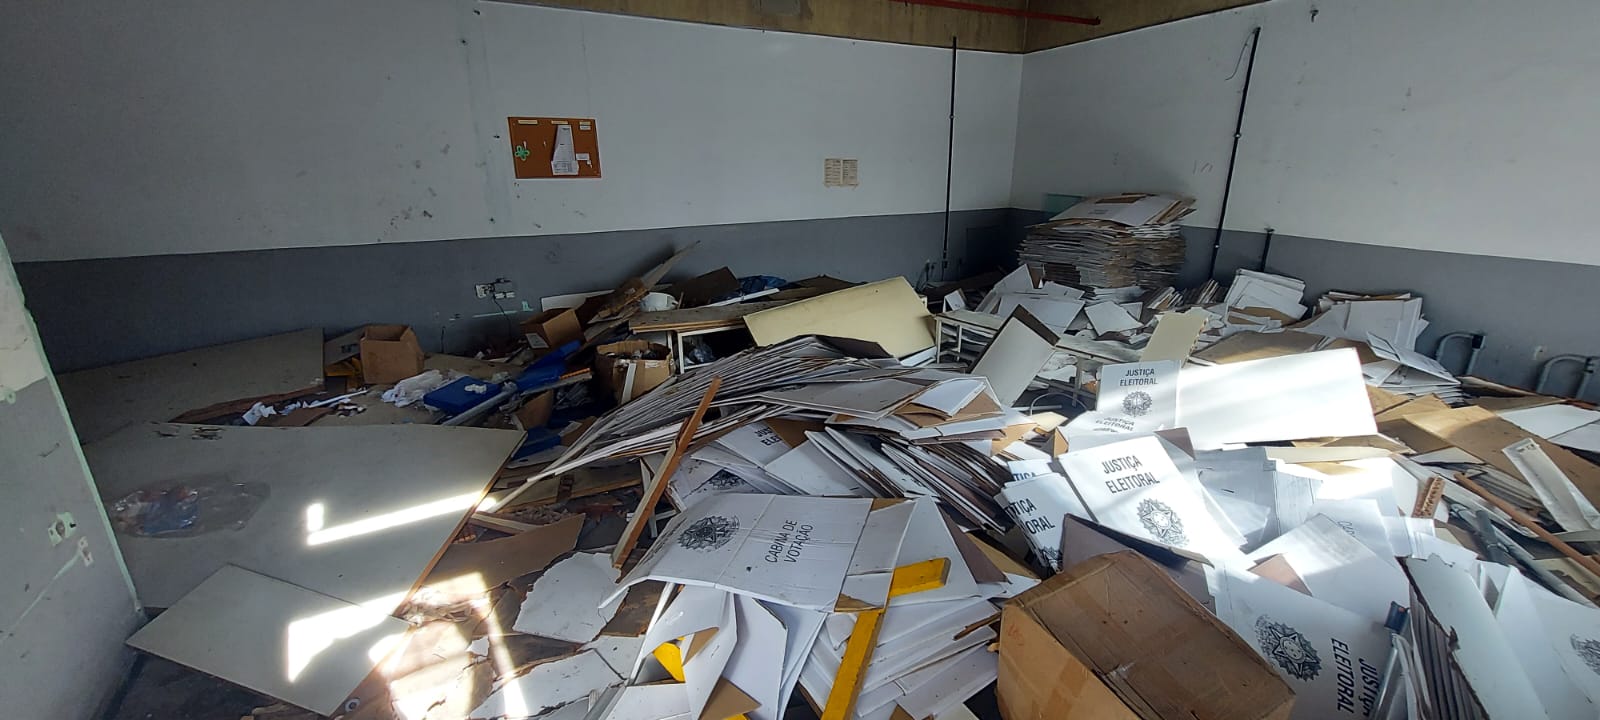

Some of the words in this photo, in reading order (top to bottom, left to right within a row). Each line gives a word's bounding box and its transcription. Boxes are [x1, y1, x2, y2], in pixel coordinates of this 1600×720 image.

[1119, 378, 1158, 387] ELEITORAL
[1125, 368, 1155, 378] JUSTIÇA
[1101, 454, 1143, 475] JUSTIÇA
[1105, 471, 1161, 494] ELEITORAL
[764, 532, 791, 563] CABINA
[782, 519, 798, 531] DE
[783, 524, 814, 563] VOTAÇÃO
[1330, 637, 1355, 714] ELEITORAL
